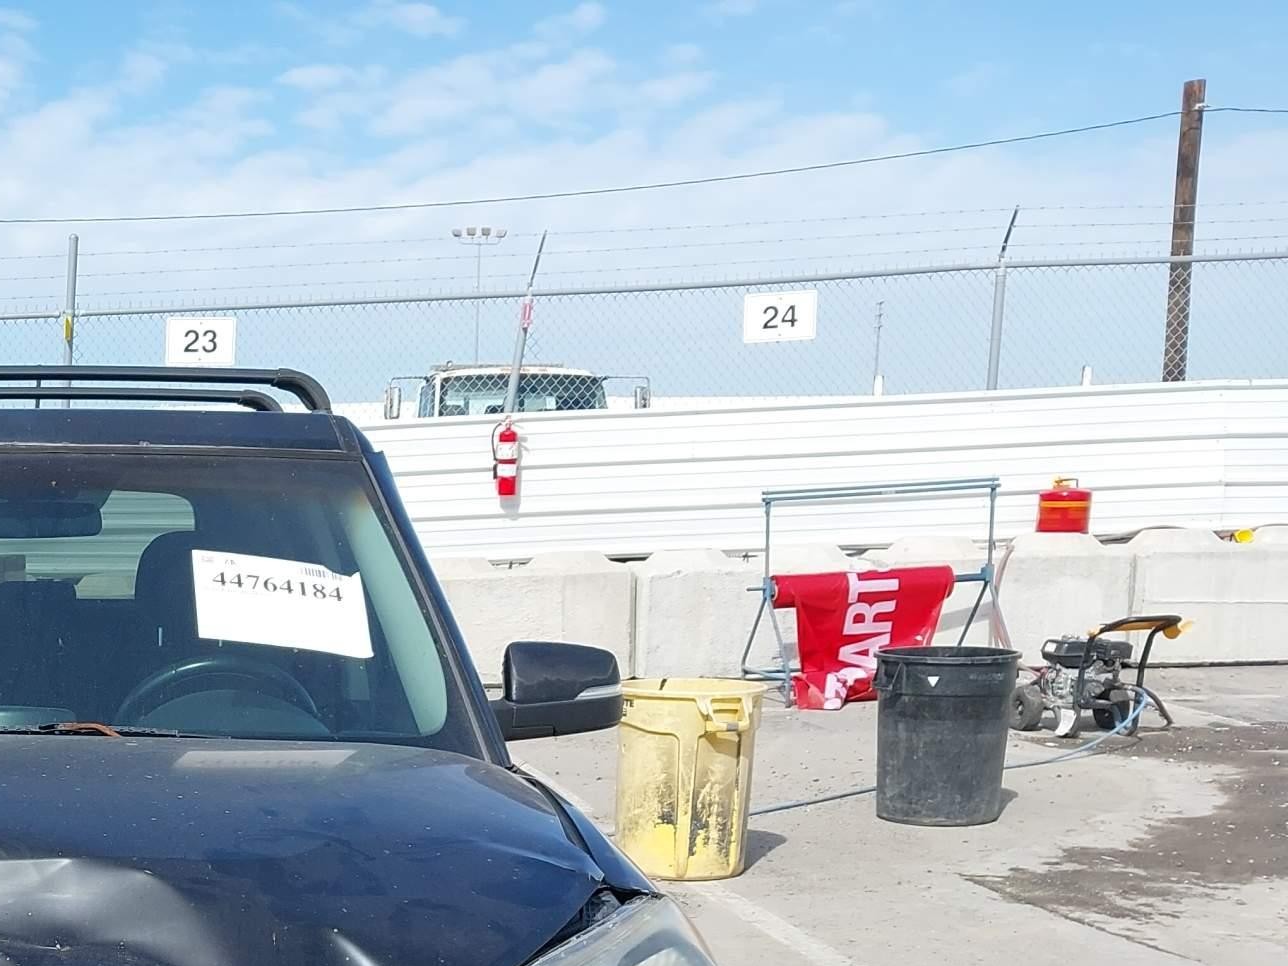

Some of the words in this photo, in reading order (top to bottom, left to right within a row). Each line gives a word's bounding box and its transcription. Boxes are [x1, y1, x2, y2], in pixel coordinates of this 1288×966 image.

[762, 304, 798, 329] 24
[183, 329, 217, 353] 23
[211, 571, 344, 602] 44764184
